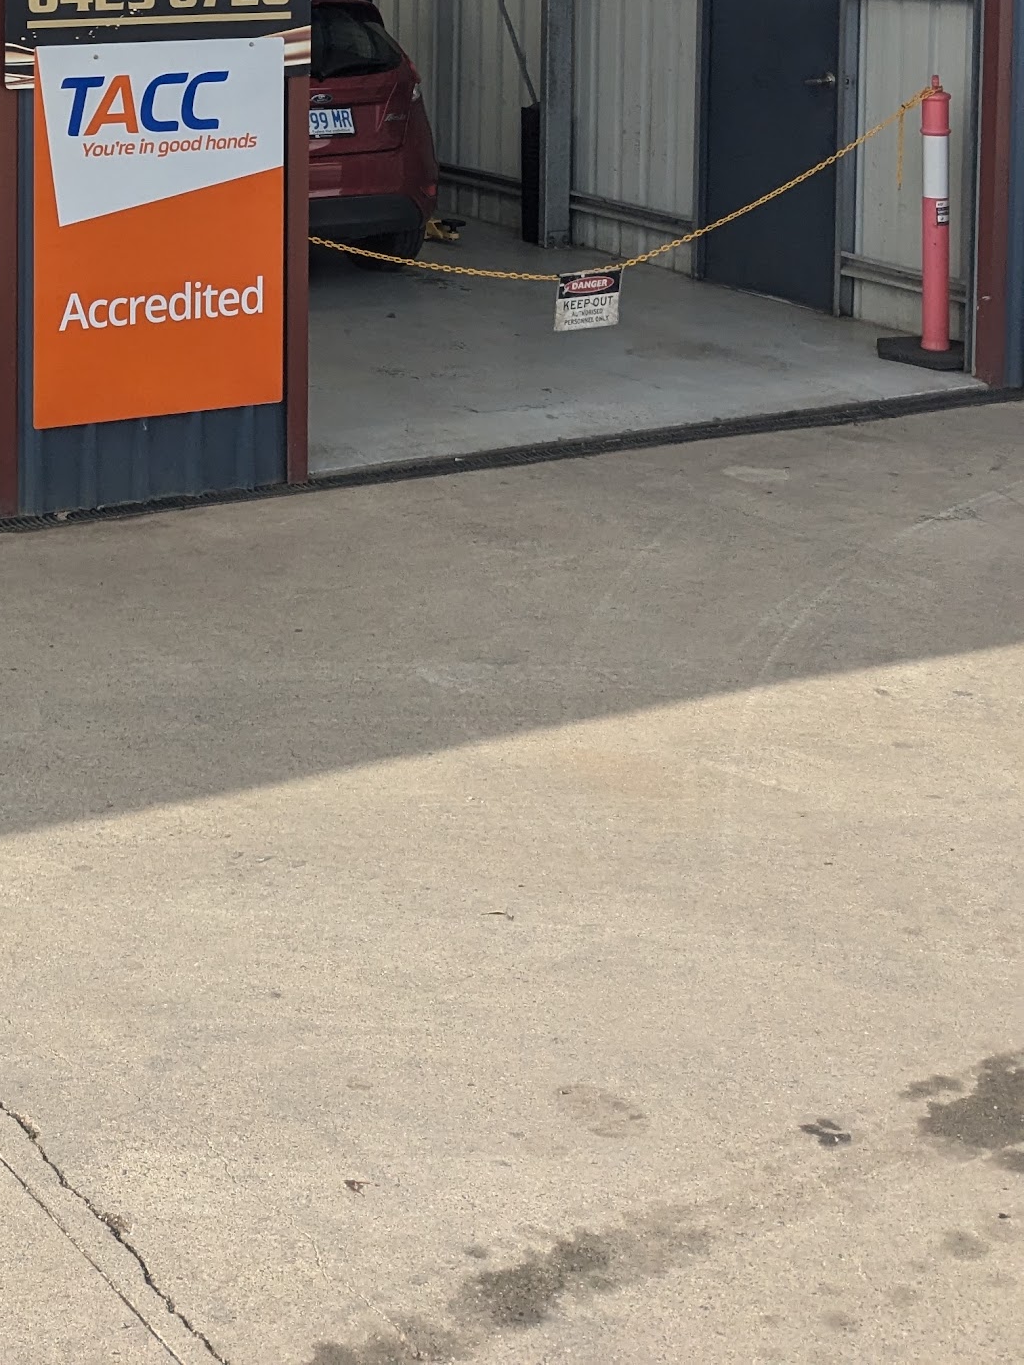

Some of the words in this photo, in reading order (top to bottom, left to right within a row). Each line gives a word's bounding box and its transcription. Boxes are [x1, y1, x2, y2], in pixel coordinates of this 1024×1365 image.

[60, 70, 230, 137] TACC
[331, 109, 353, 128] MR
[82, 140, 136, 158] You're
[139, 138, 155, 155] in
[157, 135, 203, 158] good
[205, 132, 258, 150] hands
[571, 279, 608, 290] DANGER
[58, 275, 264, 332] Accredited
[563, 298, 591, 311] KEEP
[593, 296, 614, 307] OUT
